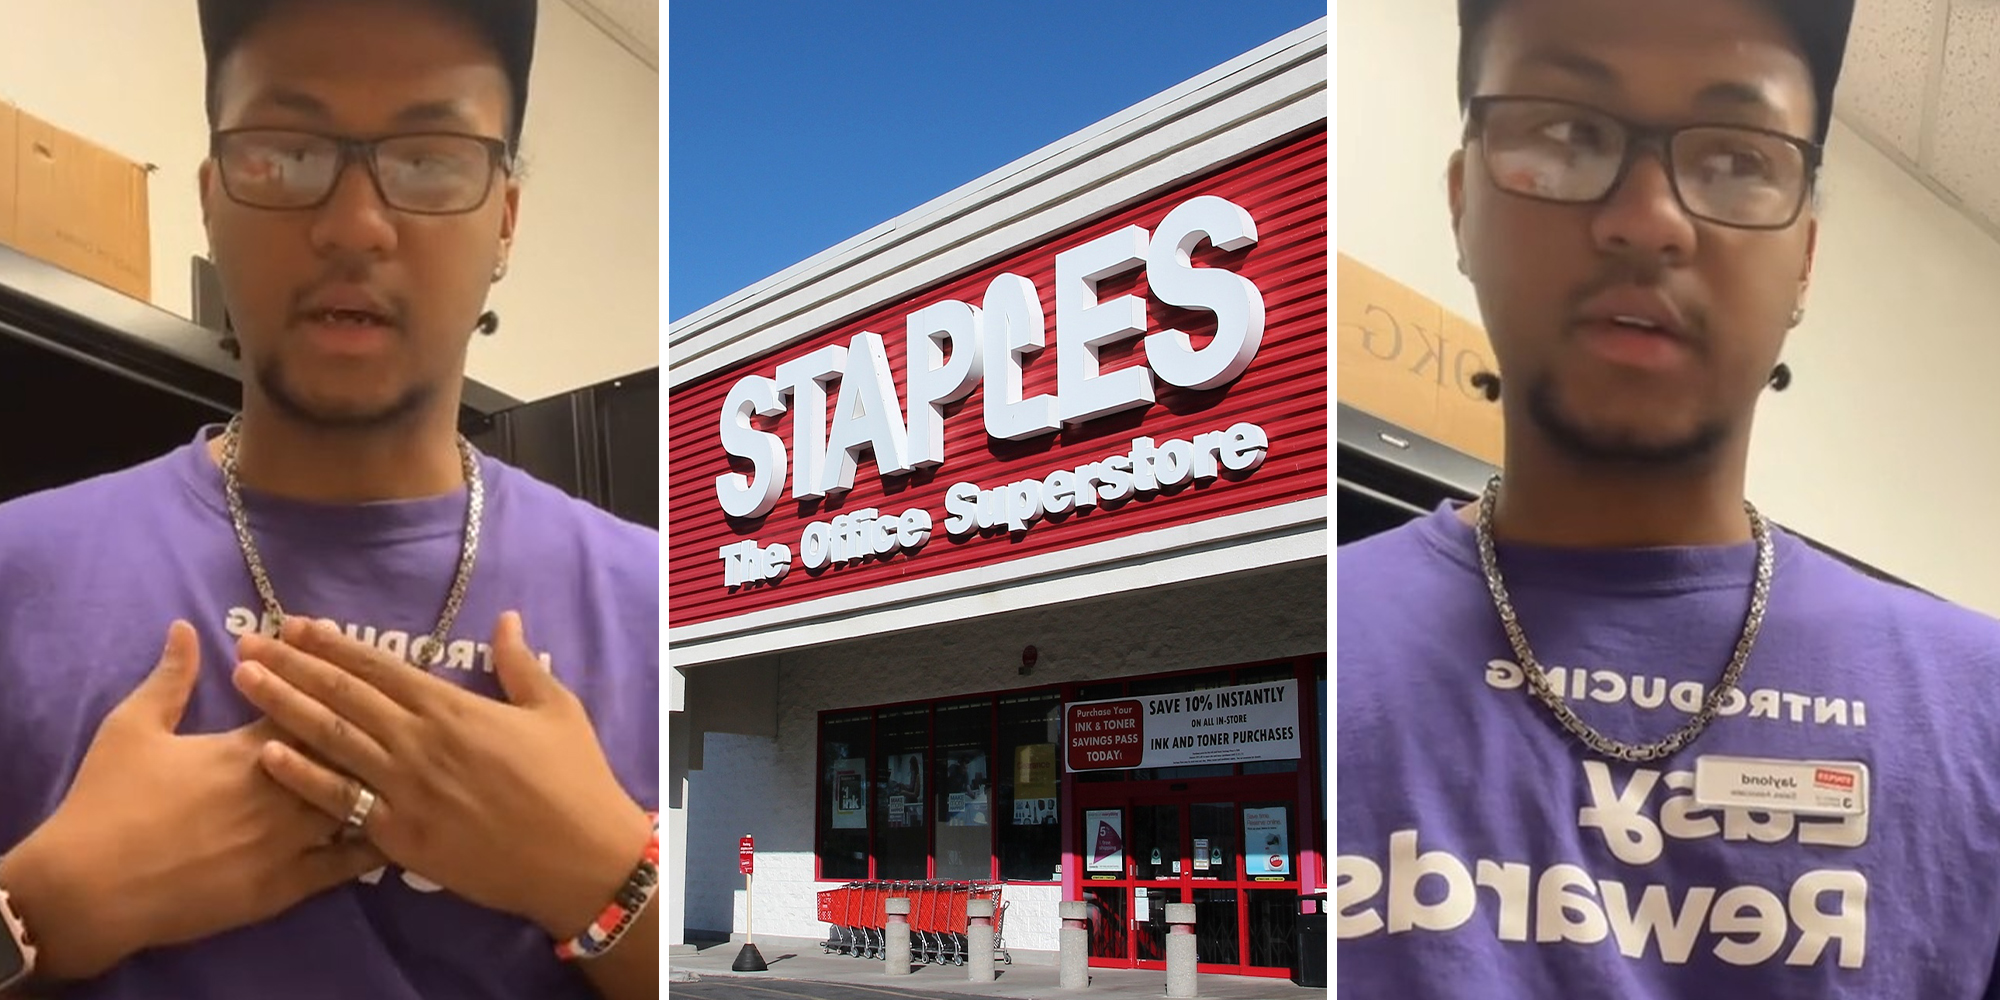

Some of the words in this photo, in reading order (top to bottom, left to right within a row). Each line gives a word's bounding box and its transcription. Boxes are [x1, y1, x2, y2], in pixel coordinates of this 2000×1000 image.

[715, 195, 1266, 519] STAPLES
[718, 540, 792, 588] The
[801, 507, 933, 571] Office
[944, 422, 1270, 538] Superstore
[1149, 698, 1180, 715] SAVE
[1185, 694, 1213, 712] 10%
[1216, 686, 1285, 708] INSTANTLY
[1076, 707, 1111, 718] Purchase
[1113, 706, 1132, 715] Your
[1191, 718, 1201, 728] ON
[1203, 717, 1214, 727] ALL
[1216, 714, 1247, 725] IN-STORE
[1075, 721, 1092, 732] INK
[1095, 721, 1101, 731] &
[1103, 718, 1136, 730] TONER
[1072, 735, 1112, 747] SAVINGS
[1115, 733, 1138, 744] PASS
[1151, 737, 1169, 750] INK
[1172, 735, 1194, 749] AND
[1197, 733, 1229, 747] TONER
[1232, 726, 1294, 744] PURCHASES
